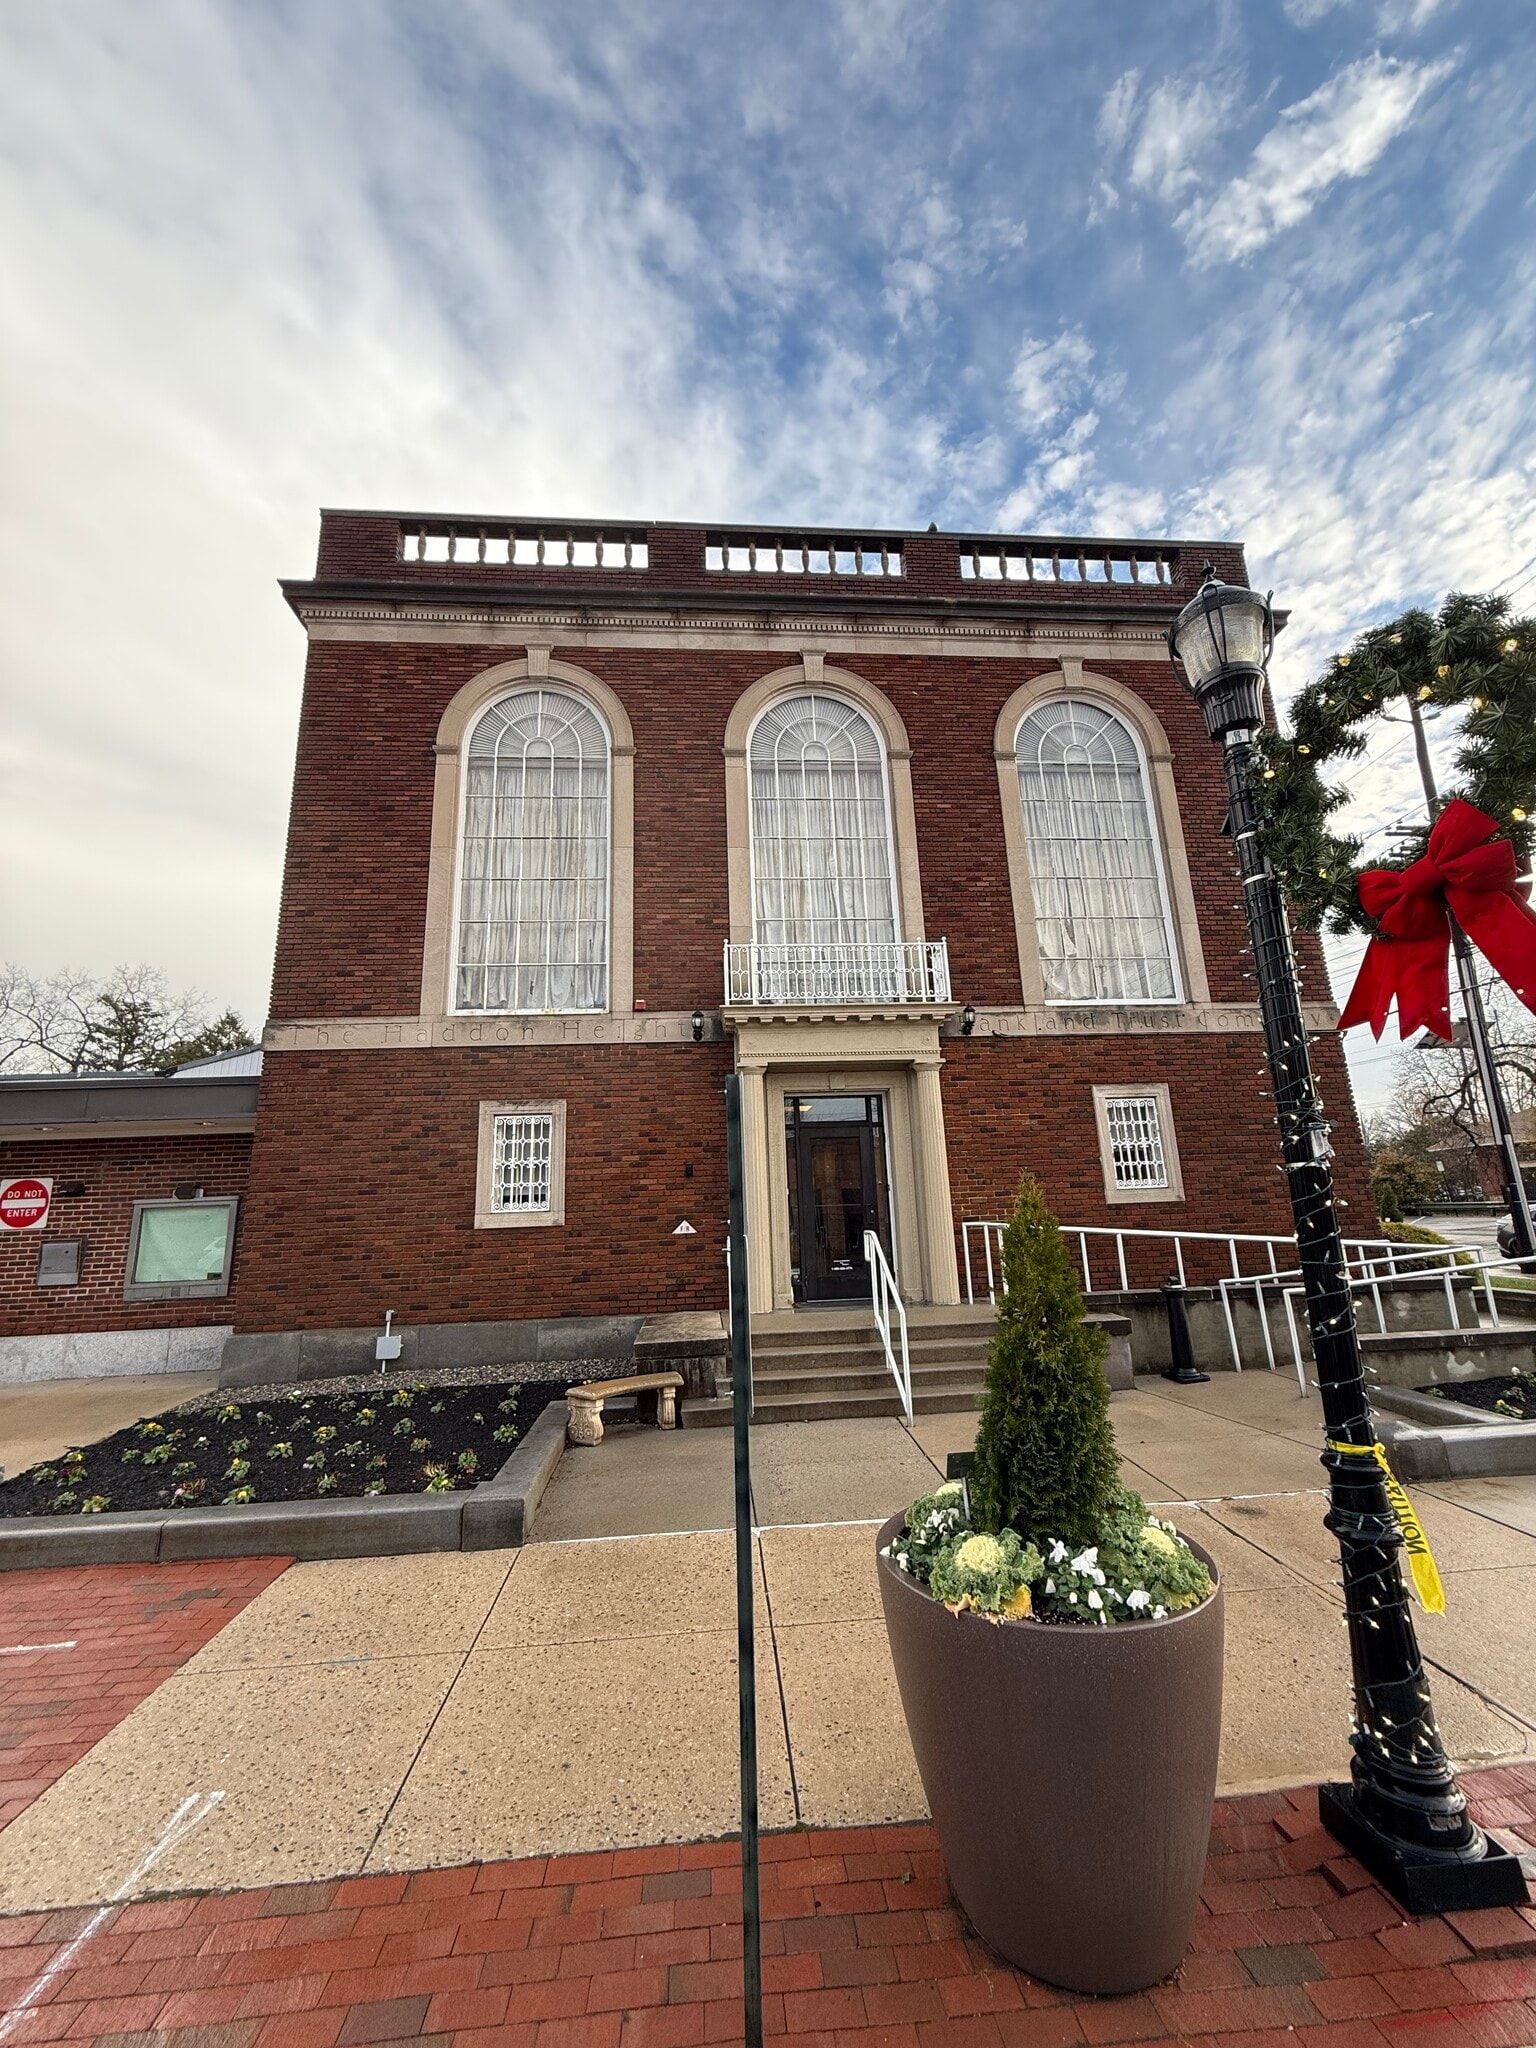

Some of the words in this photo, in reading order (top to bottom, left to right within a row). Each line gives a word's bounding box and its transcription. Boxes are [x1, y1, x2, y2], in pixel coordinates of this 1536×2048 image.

[1046, 1012, 1096, 1030] and
[1110, 1011, 1184, 1029] Trust
[1198, 1011, 1321, 1028] Comy
[289, 1026, 355, 1045] The
[384, 1023, 535, 1043] Haddon
[561, 1021, 689, 1041] Height
[7, 1190, 21, 1199] DO
[24, 1189, 43, 1198] NOT
[6, 1208, 38, 1218] ENTER
